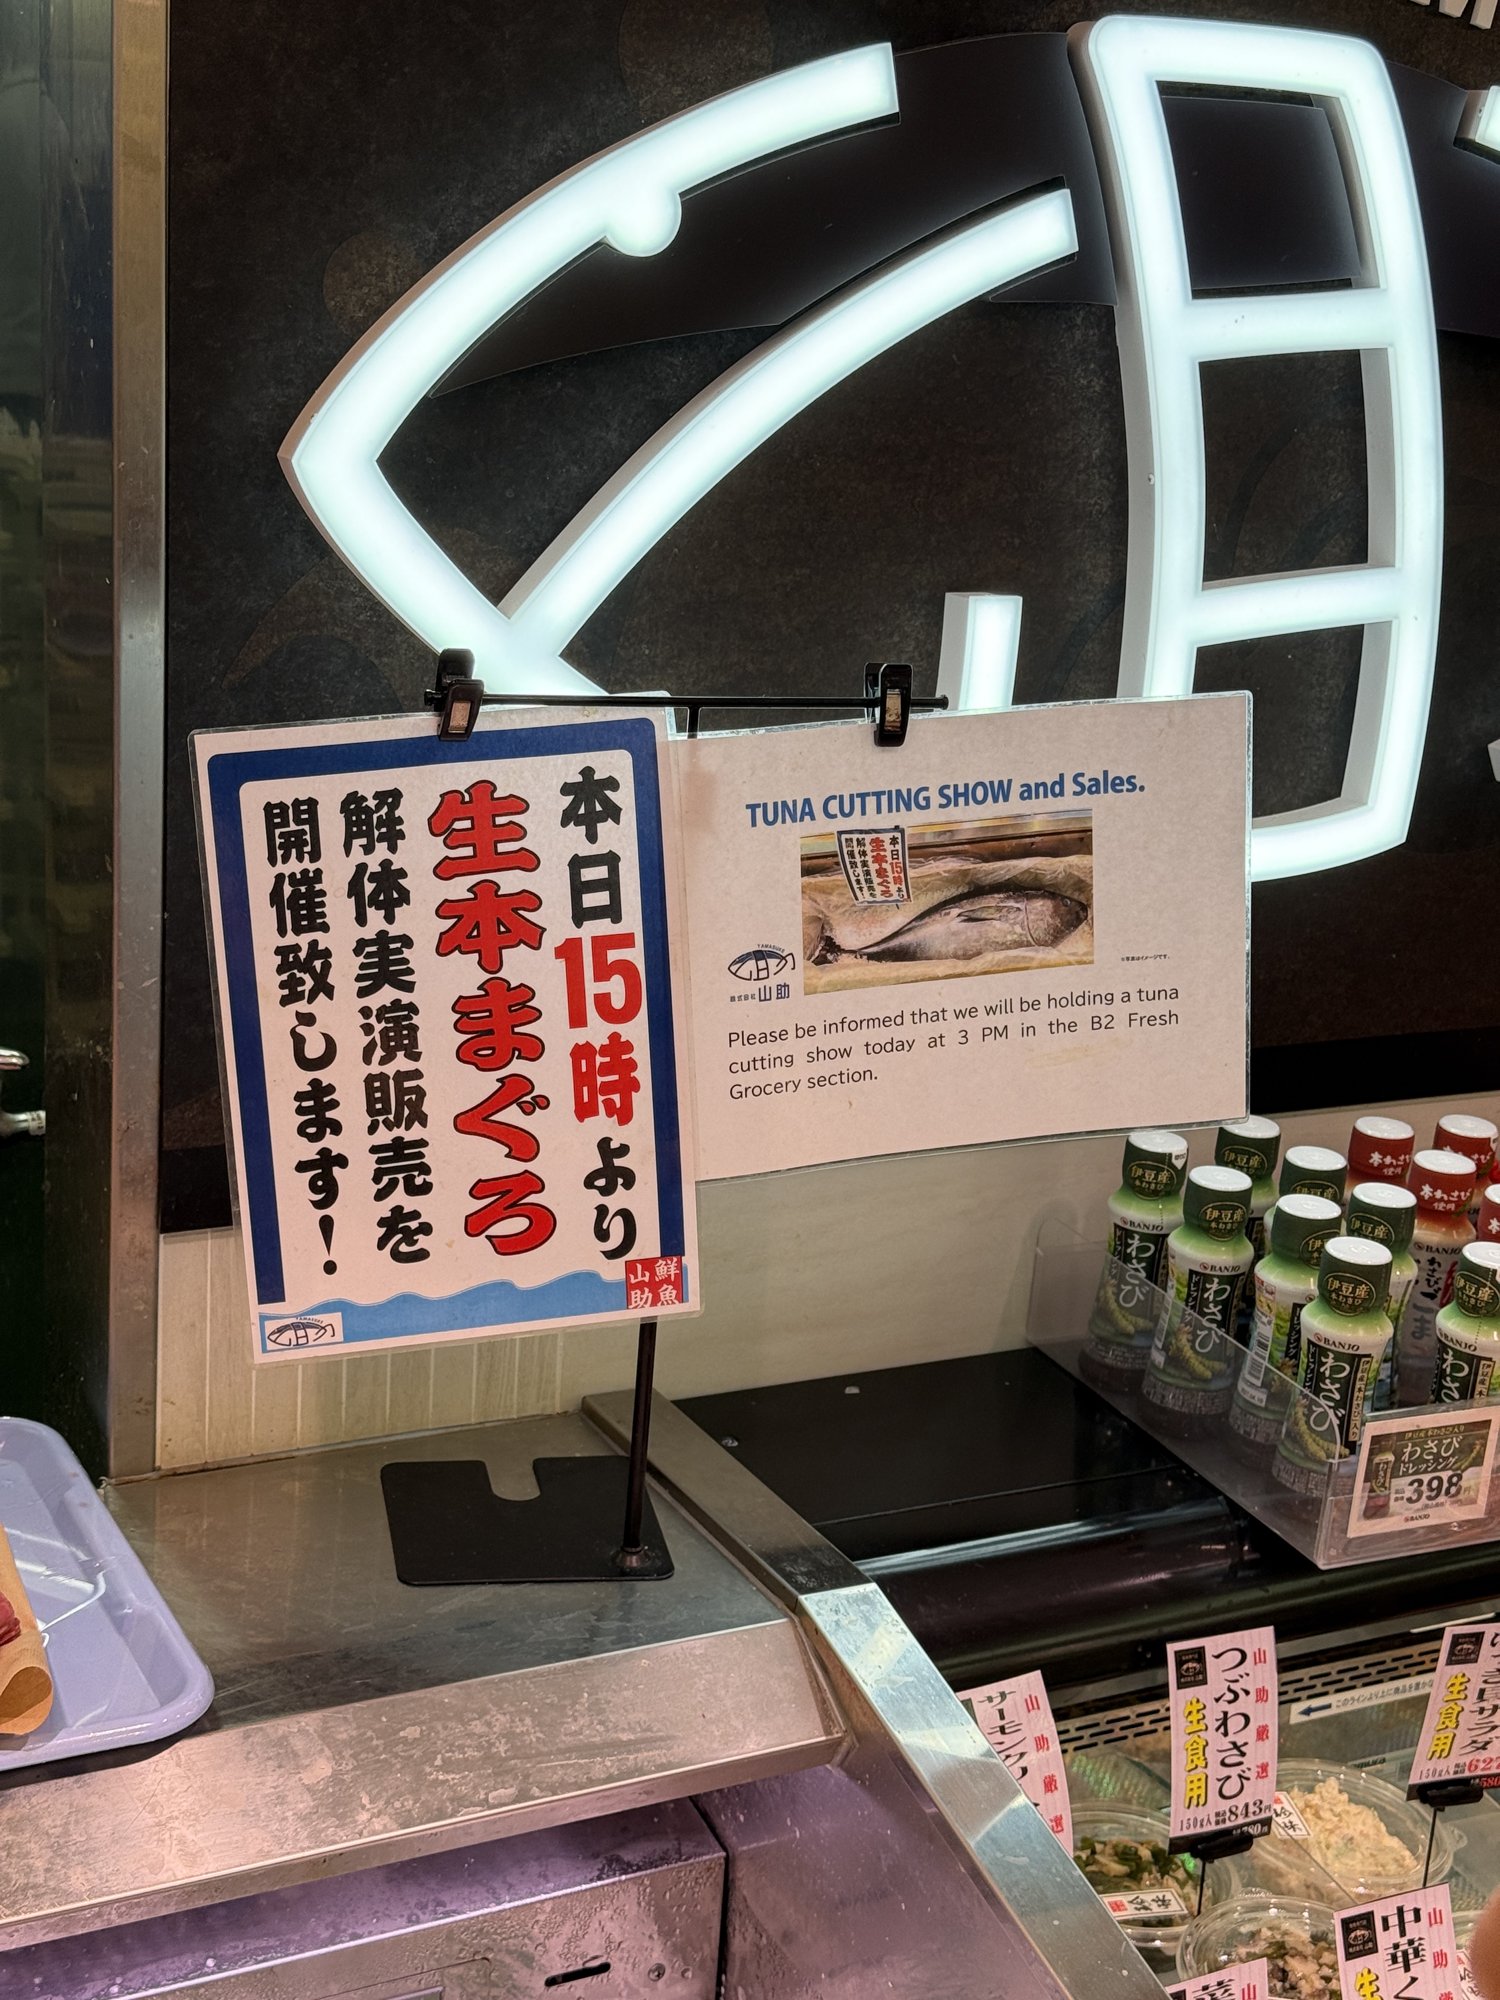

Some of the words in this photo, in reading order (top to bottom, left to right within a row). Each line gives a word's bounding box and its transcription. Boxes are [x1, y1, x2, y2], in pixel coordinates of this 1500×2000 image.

[746, 798, 815, 828] TUNA
[823, 786, 930, 819] CUTTING
[938, 779, 1012, 809] SHOW
[1019, 773, 1065, 801] and
[1072, 769, 1145, 796] Sales.
[759, 982, 790, 1002] 山助
[339, 786, 435, 1264] 解体実演販売を
[427, 779, 558, 1256] 生本まぐろ
[554, 765, 645, 1261] 本日15時より
[728, 1028, 789, 1048] Please
[795, 1022, 817, 1039] be
[823, 1010, 905, 1035] informed
[910, 1007, 948, 1024] that
[953, 1006, 979, 1021] we
[984, 997, 1014, 1017] will
[1019, 996, 1041, 1013] be
[1047, 988, 1115, 1011] holding
[1120, 991, 1132, 1004] a
[1137, 987, 1179, 1003] tuna
[729, 1052, 794, 1075] cutting
[806, 1045, 853, 1064] show
[864, 1036, 915, 1058] today
[927, 1032, 946, 1049] at
[958, 1029, 969, 1046] 3
[982, 1025, 1009, 1043] PM
[1020, 1021, 1037, 1038] in
[1048, 1017, 1078, 1035] the
[1091, 1013, 1115, 1031] B2
[1128, 1010, 1179, 1028] Fresh
[729, 1077, 801, 1101] Grocery
[807, 1067, 878, 1090] section.
[1130, 1165, 1171, 1184] 伊豆産
[1420, 1184, 1472, 1201] 本わさび
[1128, 1219, 1164, 1232] BANJO
[1205, 1208, 1244, 1223] 伊豆産
[1351, 1218, 1389, 1239] 伊豆産
[1119, 1233, 1155, 1307] わさび
[1210, 1264, 1241, 1273] BANJO
[1327, 1276, 1370, 1298] 伊豆産
[1456, 1275, 1495, 1299] 伊豆産
[1195, 1277, 1231, 1353] わさび
[1323, 1337, 1360, 1352] BANJO
[1443, 1333, 1477, 1352] BANJO
[1309, 1351, 1350, 1432] わさび
[1399, 1456, 1458, 1476] ドレッシング
[1401, 1436, 1462, 1462] わさび
[1405, 1472, 1463, 1504] 398
[1211, 1647, 1251, 1800] つぶわさび
[1253, 1647, 1270, 1780] 山助厳選
[1427, 1672, 1470, 1761] 生食用
[1024, 1694, 1065, 1834] 山助厳選
[1183, 1696, 1209, 1810] 生食用
